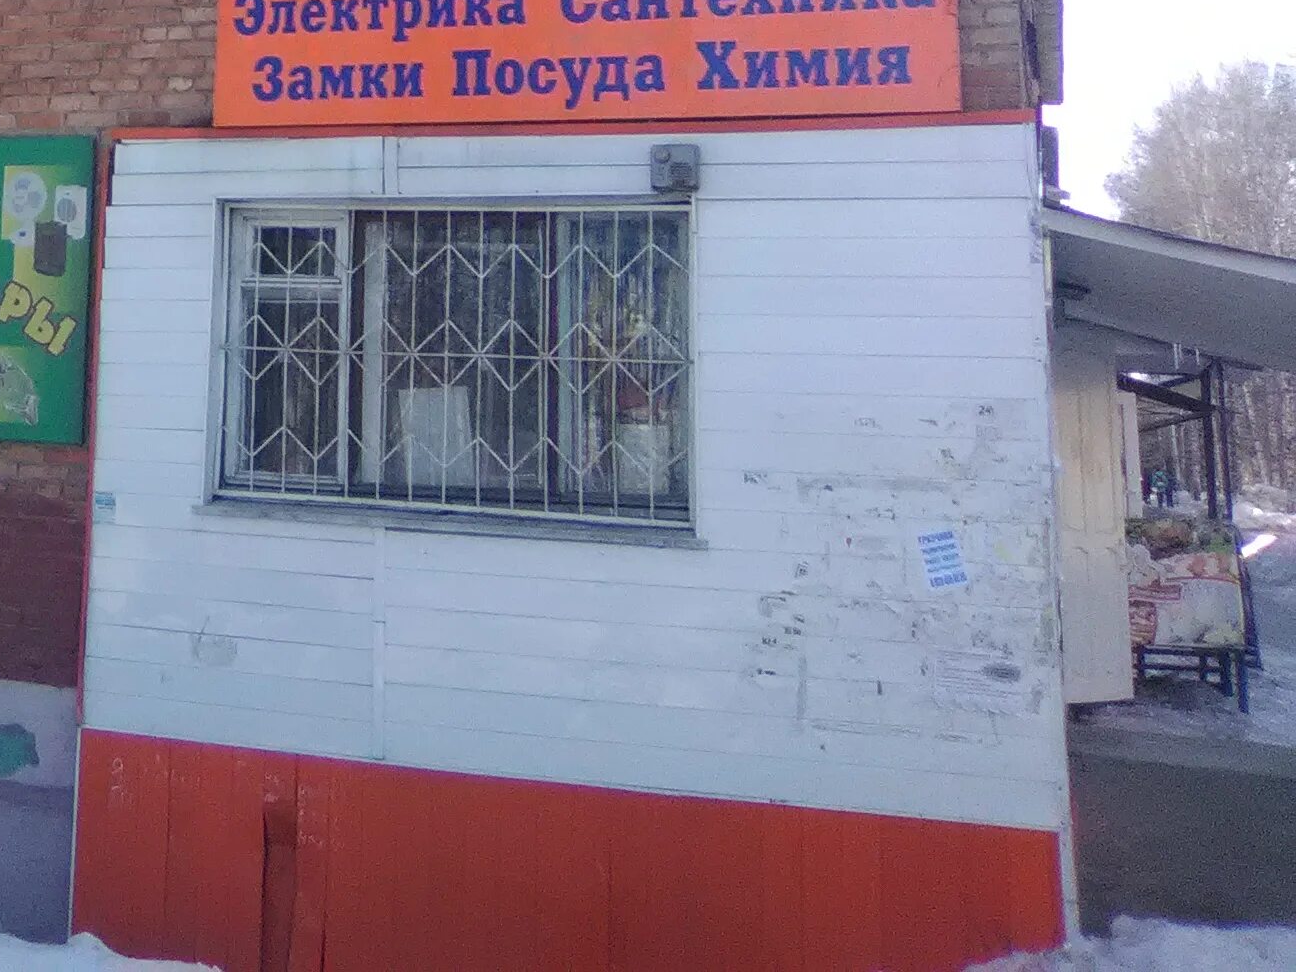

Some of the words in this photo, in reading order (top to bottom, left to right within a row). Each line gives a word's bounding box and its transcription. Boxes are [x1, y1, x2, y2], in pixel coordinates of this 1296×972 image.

[253, 55, 424, 102] Замки
[452, 48, 665, 108] Посуда
[696, 41, 911, 90] Химия
